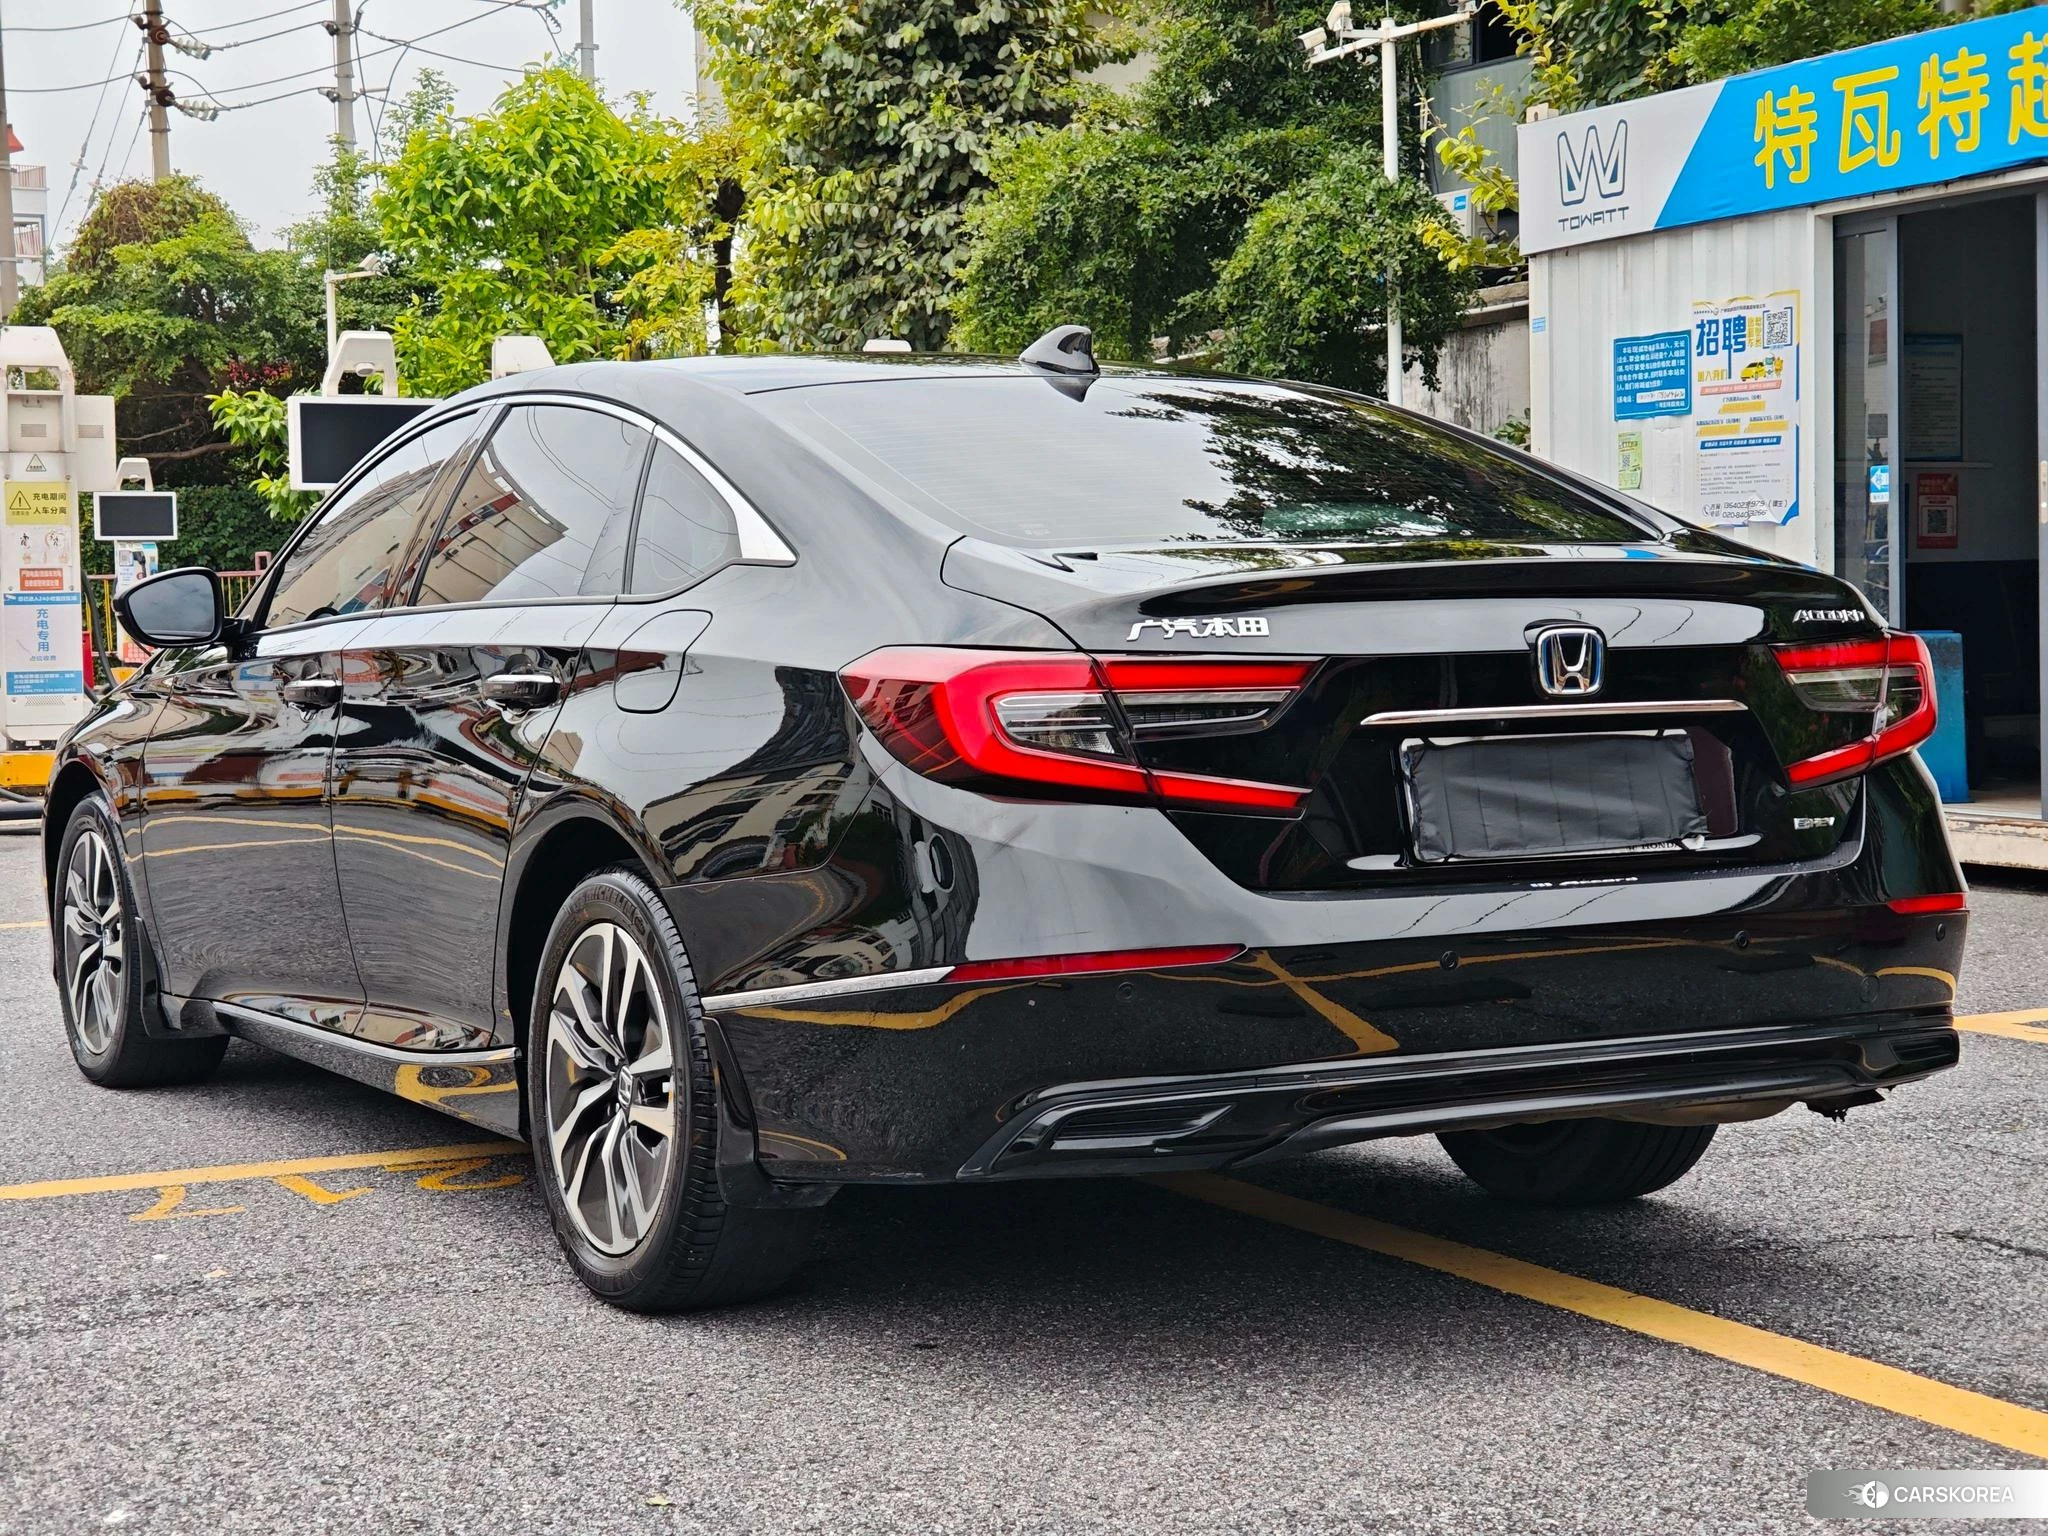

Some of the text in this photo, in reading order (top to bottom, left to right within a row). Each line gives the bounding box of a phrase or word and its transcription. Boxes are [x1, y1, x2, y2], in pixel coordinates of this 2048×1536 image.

[1558, 206, 1629, 232] TOWATT
[1696, 315, 1747, 357] 招聘
[32, 492, 67, 501] 充电期间
[32, 506, 67, 515] 人车分离
[36, 608, 49, 652] 充电专用
[1125, 616, 1270, 642] 广汽本田
